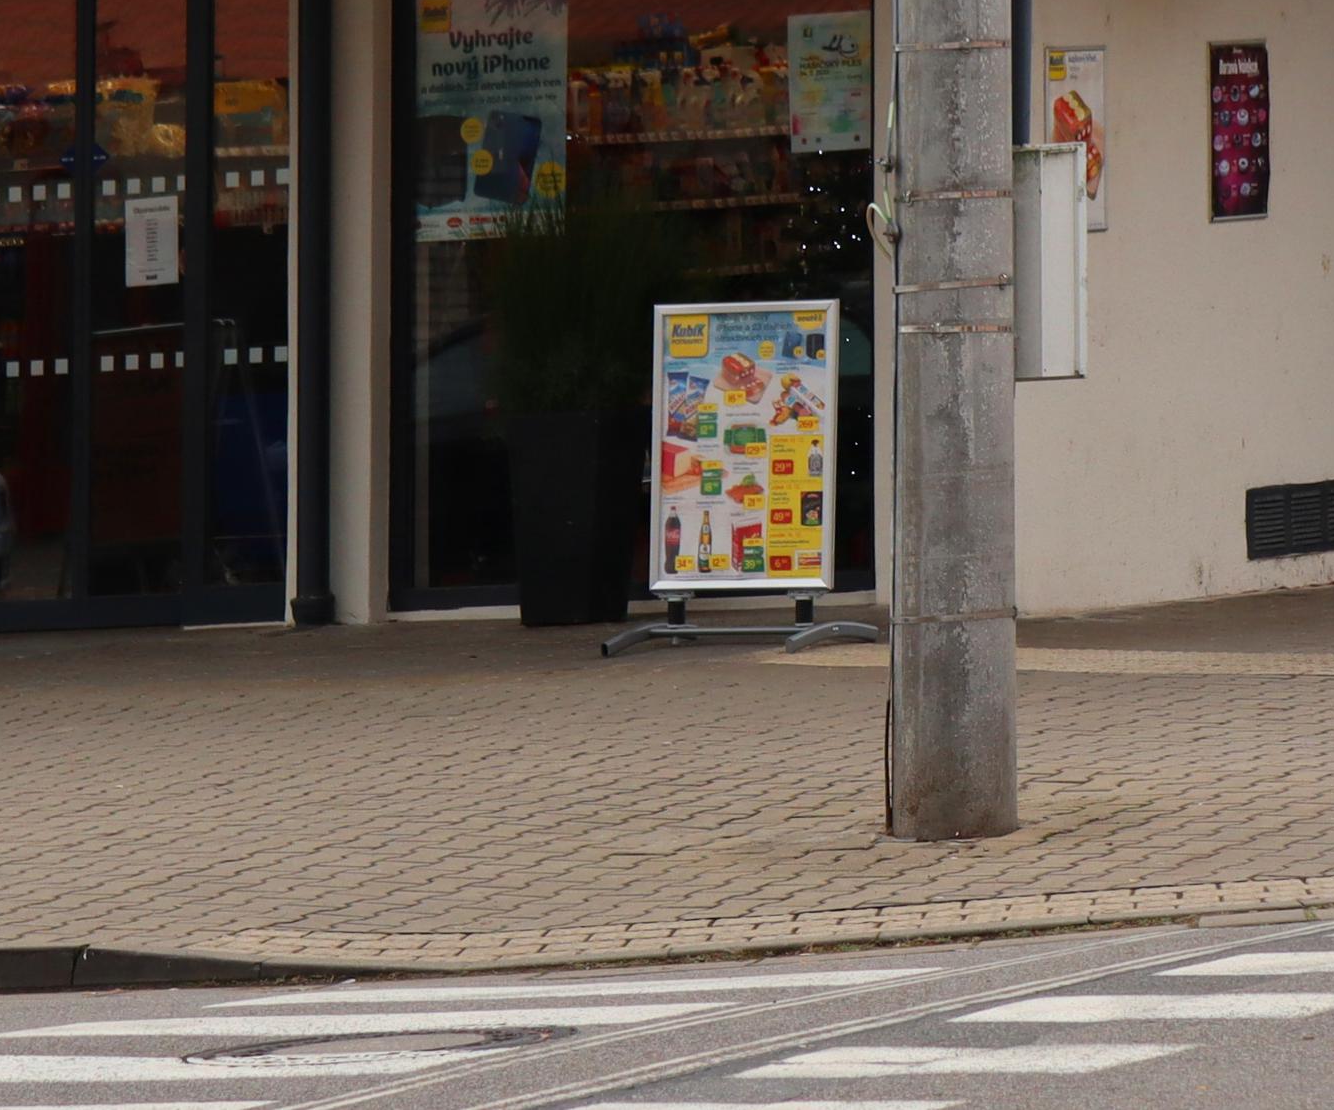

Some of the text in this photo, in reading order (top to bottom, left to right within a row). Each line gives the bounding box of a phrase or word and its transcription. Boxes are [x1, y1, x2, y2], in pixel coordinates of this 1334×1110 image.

[449, 27, 534, 54] Vyhrajte
[432, 53, 551, 81] nový iPhone
